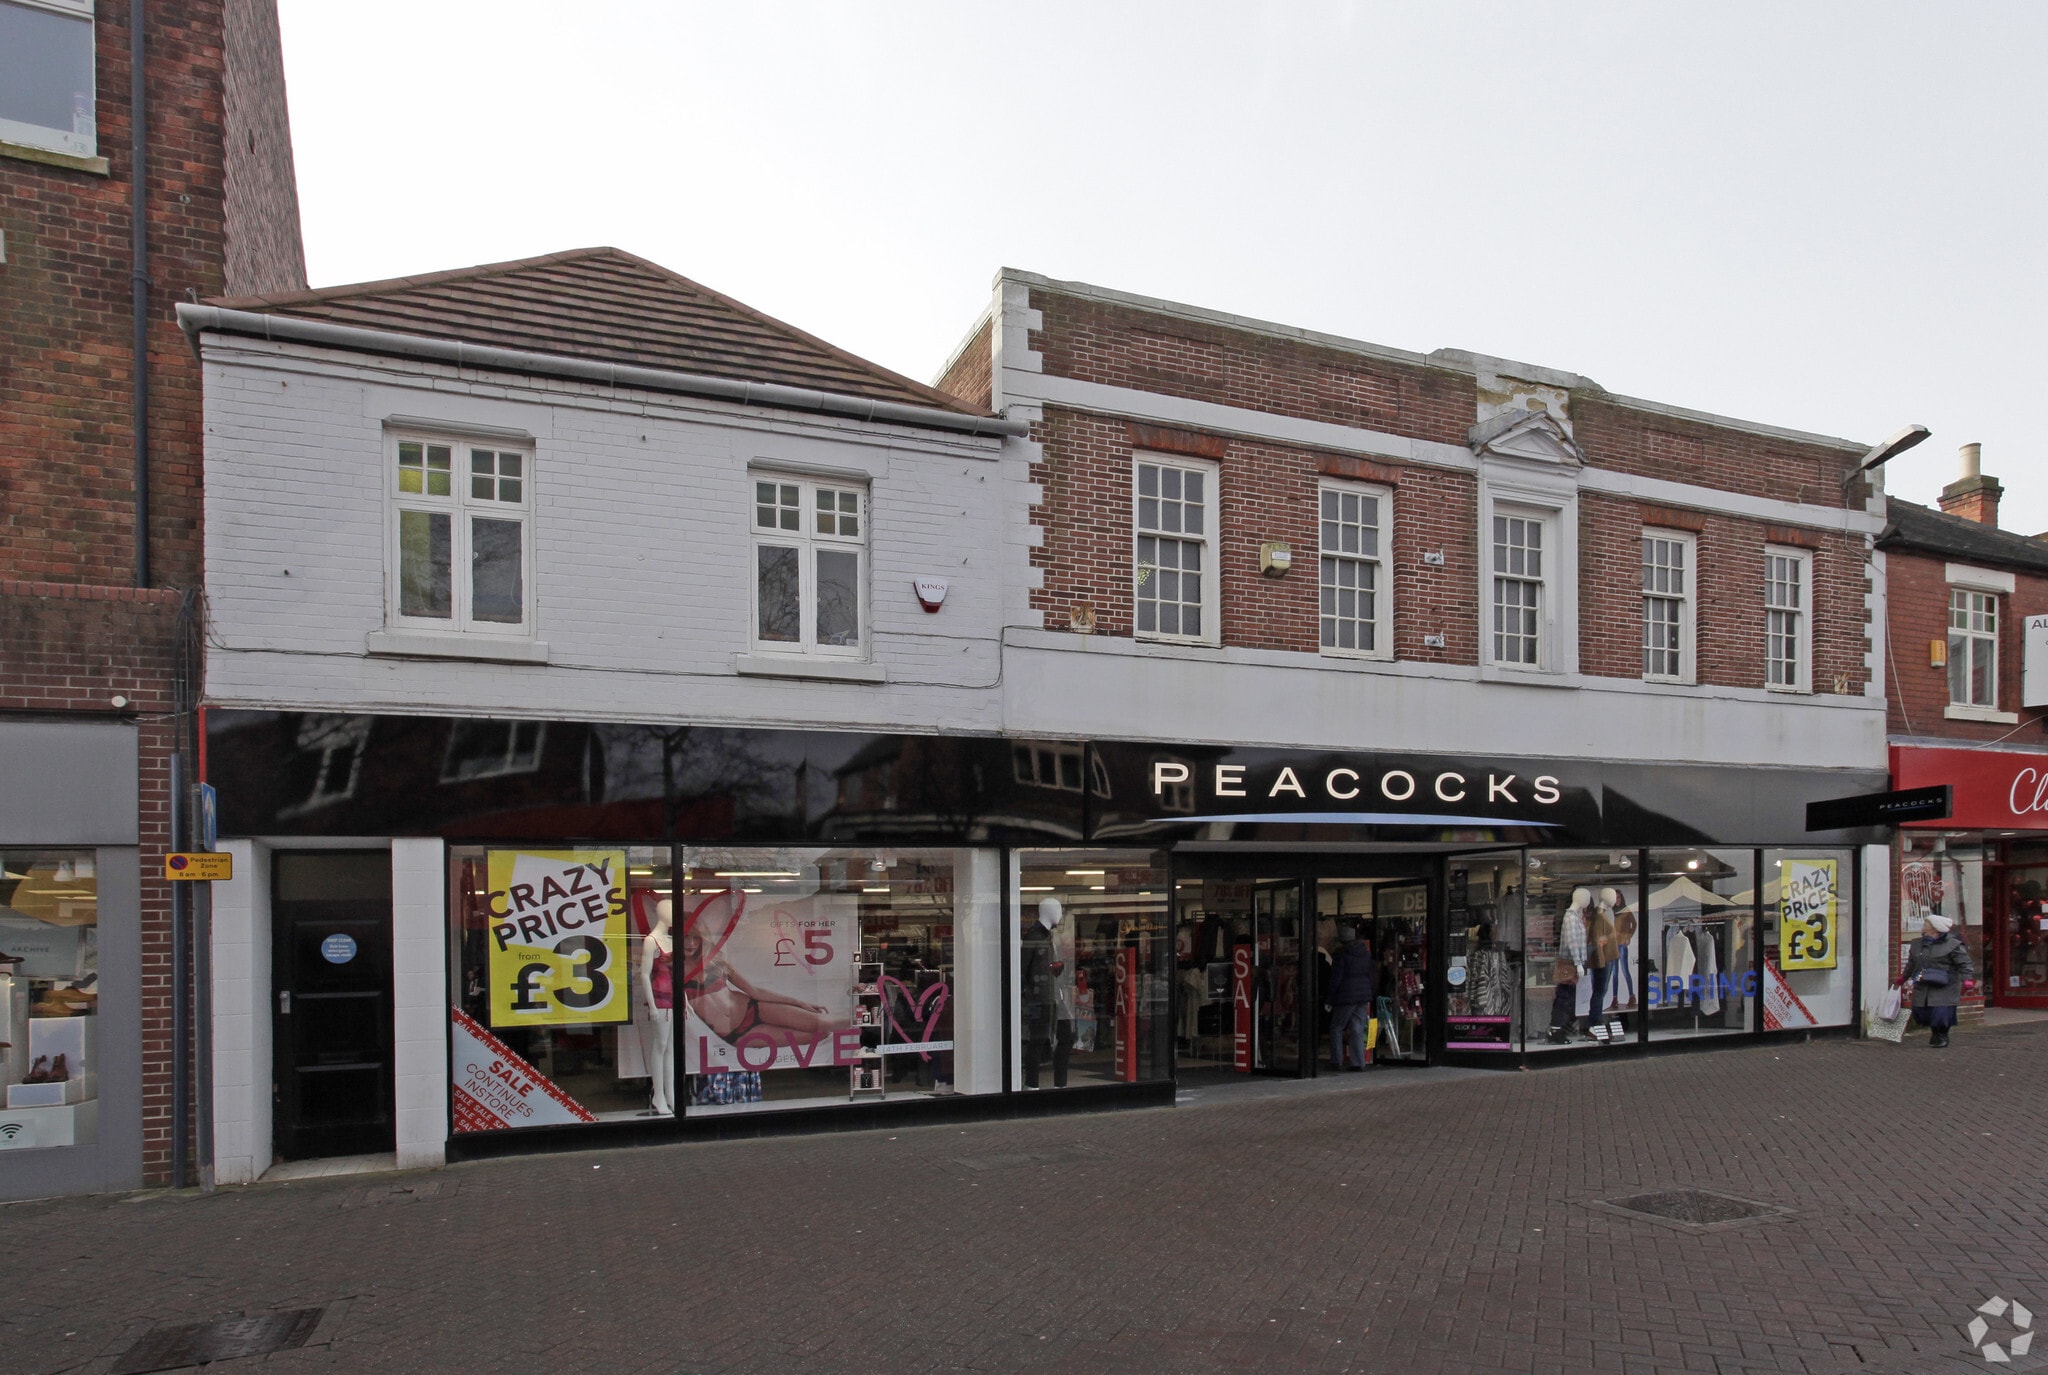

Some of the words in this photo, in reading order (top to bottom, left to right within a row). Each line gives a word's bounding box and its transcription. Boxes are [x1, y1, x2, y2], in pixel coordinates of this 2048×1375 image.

[1154, 762, 1560, 804] PEACOCKS
[1880, 798, 1942, 809] PEACOCKS
[488, 857, 611, 919] CRAZY
[1781, 864, 1831, 903] CRAZY
[1782, 883, 1838, 923] PRICES
[493, 887, 628, 953] PRICES
[770, 921, 796, 929] GIFTS
[818, 920, 836, 928] HER
[1788, 912, 1829, 960] £3
[518, 952, 541, 961] from
[774, 929, 835, 967] £5
[510, 934, 611, 1010] £3
[1648, 970, 1758, 1004] SPRING
[1115, 953, 1127, 1076] SALE
[1234, 949, 1249, 1067] SALE
[1774, 985, 1793, 1009] SALE
[699, 1028, 862, 1075] LOVE
[905, 1042, 949, 1051] FEBRUARY
[466, 1063, 533, 1118] CONTINUES
[489, 1061, 534, 1097] SALE
[454, 1090, 474, 1106] SALE
[473, 1105, 493, 1121] SALE
[455, 1103, 475, 1119] SALE
[465, 1079, 515, 1120] INSTORE
